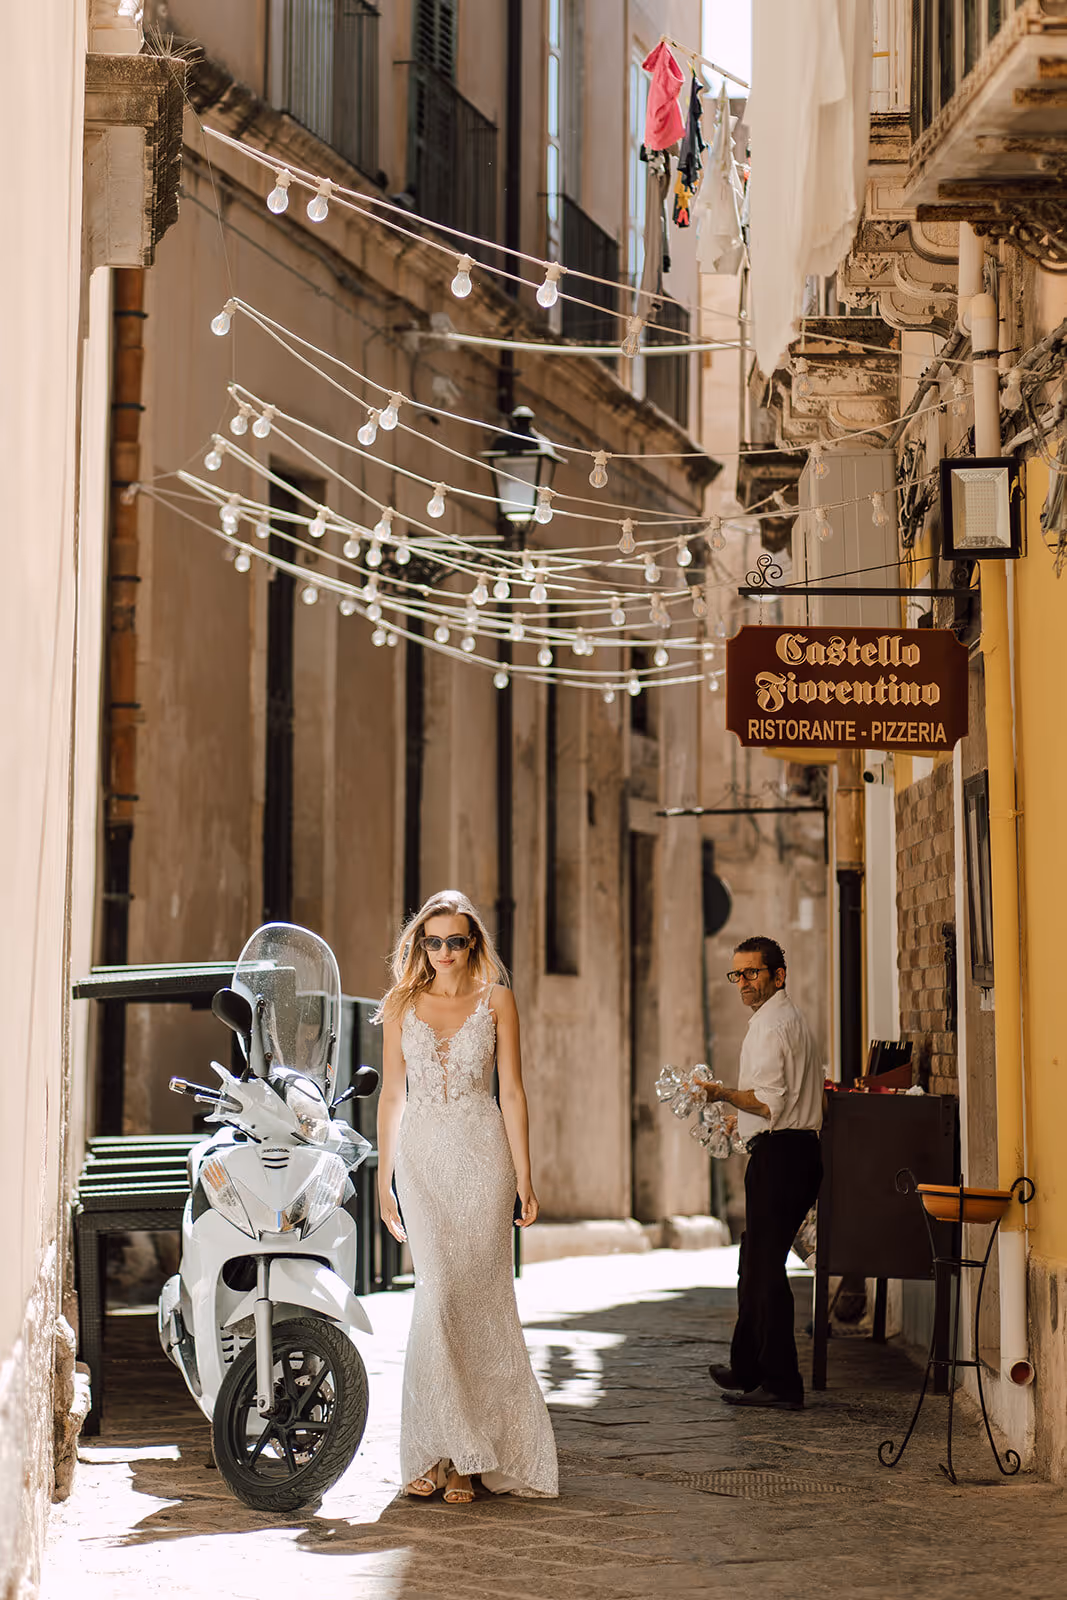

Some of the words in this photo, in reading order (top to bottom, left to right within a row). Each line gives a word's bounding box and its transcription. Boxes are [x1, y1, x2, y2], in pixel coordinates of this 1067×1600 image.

[775, 632, 920, 667] Castello
[755, 671, 940, 712] Fiorentino
[748, 719, 856, 741] RISTORANTE
[871, 721, 947, 743] PIZZERIA
